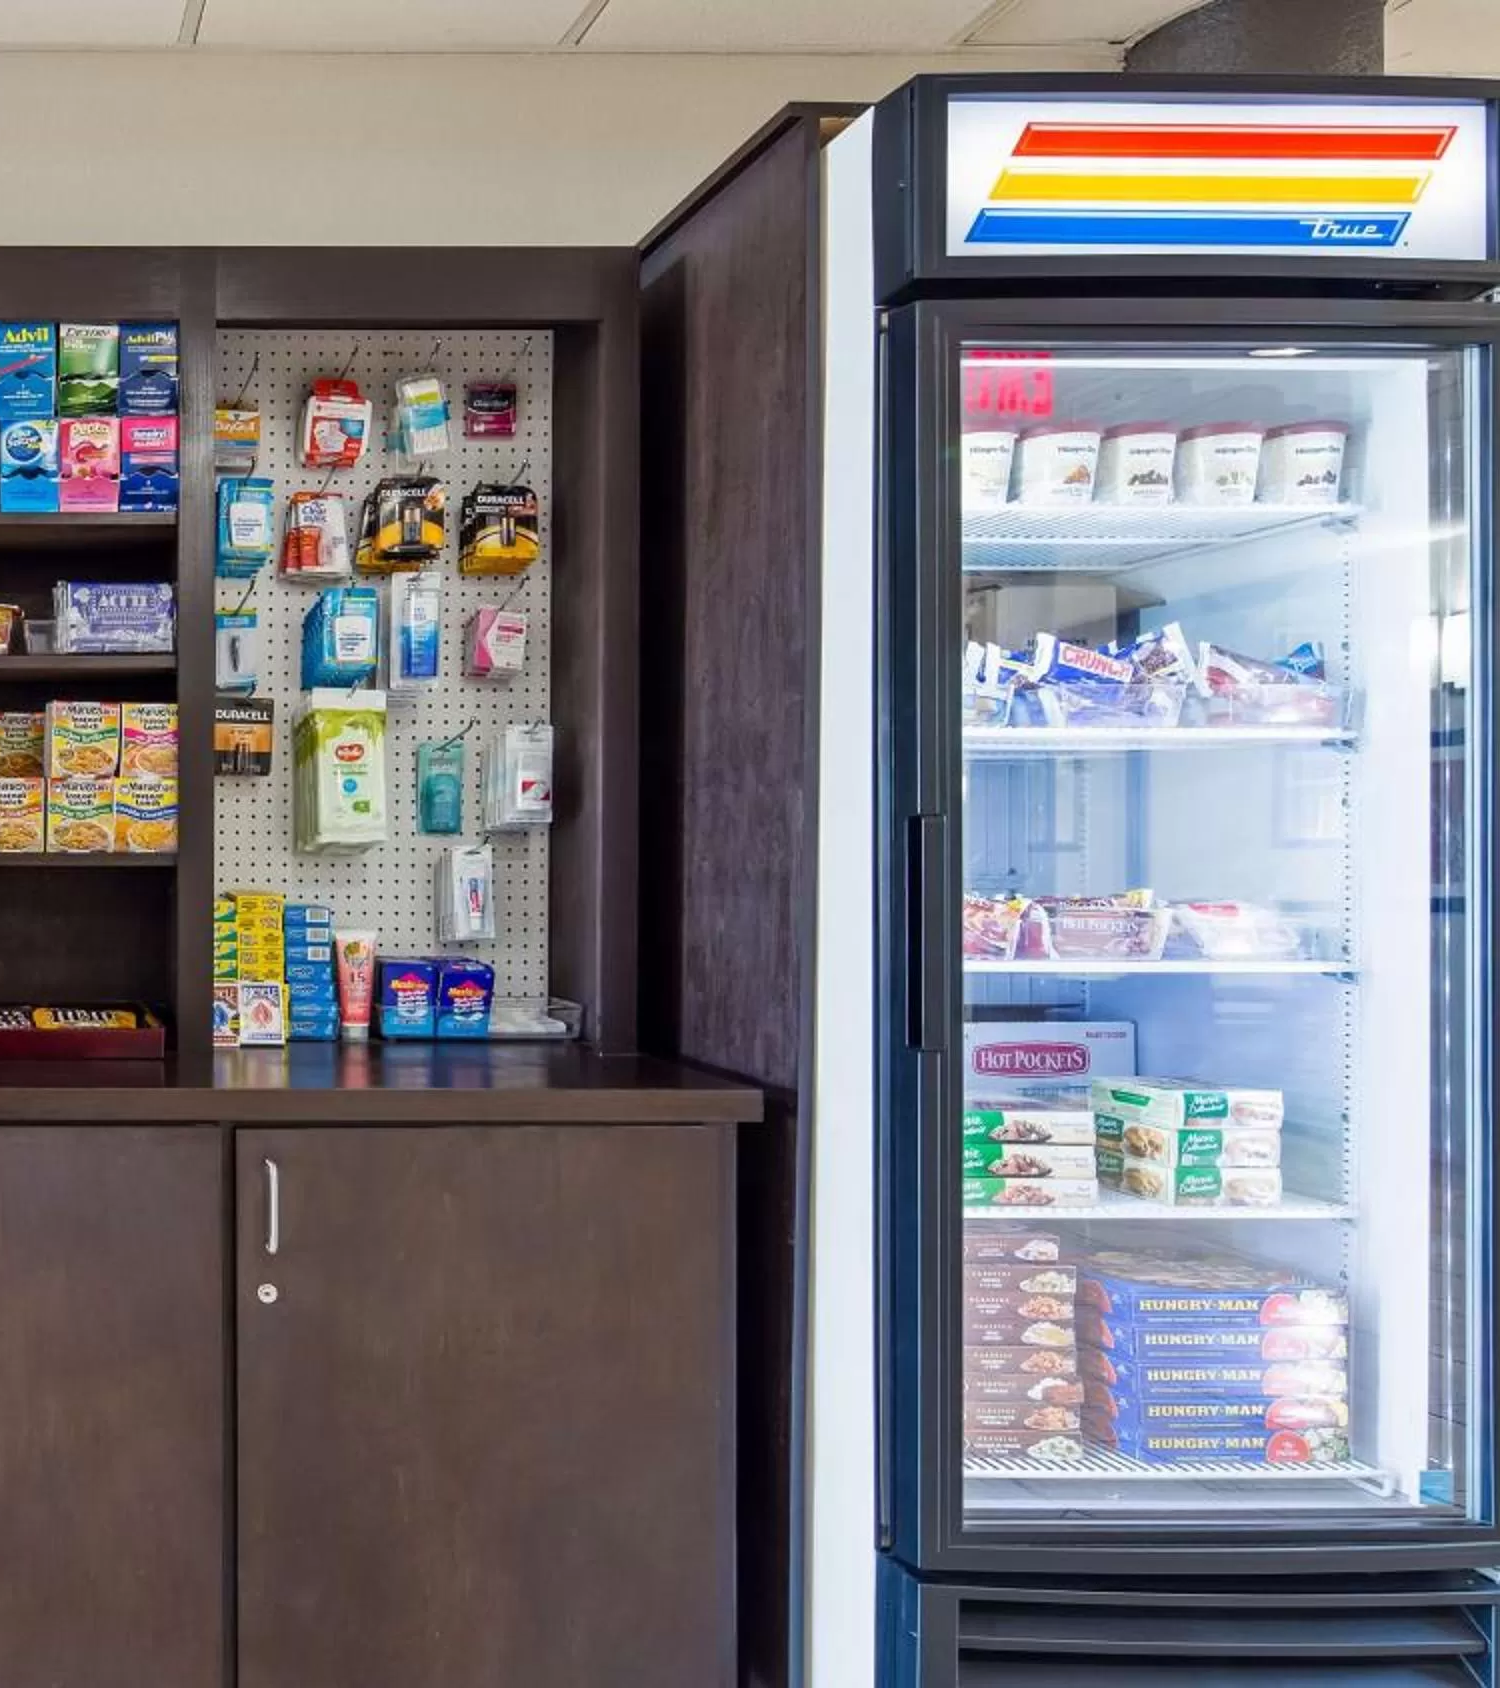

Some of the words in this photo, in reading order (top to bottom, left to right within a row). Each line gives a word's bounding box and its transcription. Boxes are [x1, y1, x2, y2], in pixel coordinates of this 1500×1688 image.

[1299, 218, 1383, 239] true
[4, 327, 49, 344] Advil
[126, 335, 155, 345] Advil
[477, 495, 525, 505] DURACELL
[1061, 644, 1132, 682] CRUNCH
[214, 708, 270, 721] DURACELL
[350, 972, 366, 983] 15
[980, 1049, 1013, 1069] HOT
[1014, 1048, 1084, 1070] POCKETS
